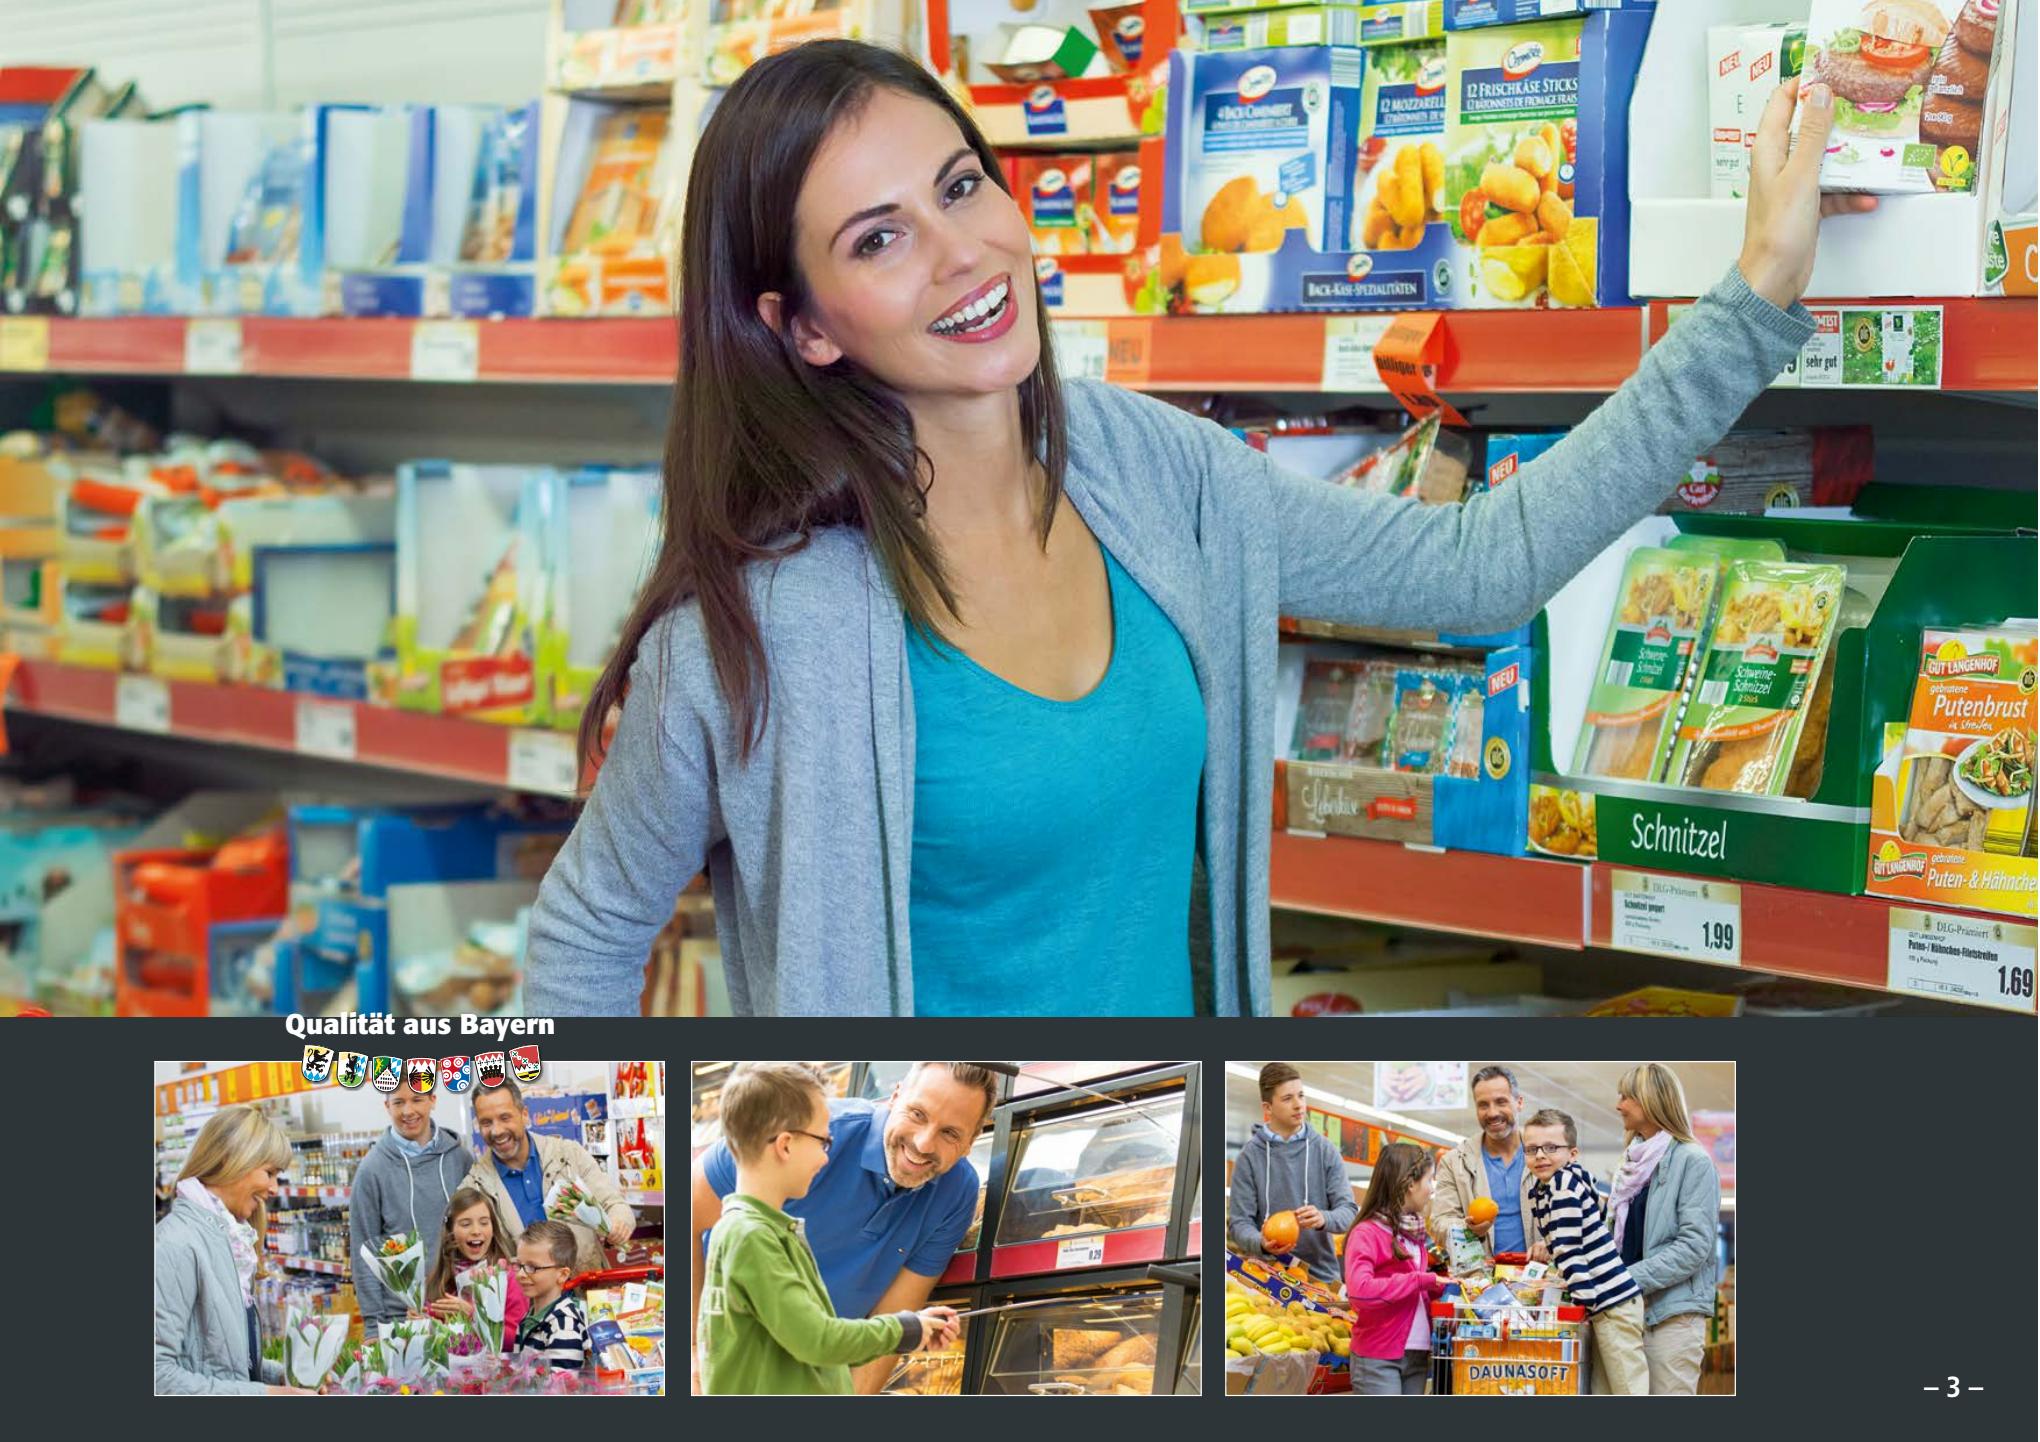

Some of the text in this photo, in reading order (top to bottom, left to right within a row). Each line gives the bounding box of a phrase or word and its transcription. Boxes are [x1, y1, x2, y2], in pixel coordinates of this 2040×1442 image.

[1467, 77, 1578, 98] 12 FRISCHKÄSE STICKS
[1806, 355, 1823, 368] sehr
[1824, 355, 1838, 371] gut
[1491, 456, 1514, 483] NEU
[1928, 658, 1999, 675] GUT LANGENHOF
[1490, 666, 1516, 692] NEU
[1733, 679, 1773, 694] Schnitzel
[1933, 694, 2029, 718] Putenbrust
[1630, 812, 1728, 860] Schnitzel
[1874, 859, 1926, 874] GUT LANGENHOF
[1927, 868, 1967, 888] Puten-
[1968, 872, 1979, 889] &
[1702, 921, 1734, 951] 1,99
[1998, 965, 2034, 998] 1,69
[1469, 1364, 1569, 1382] DAUNASOFT
